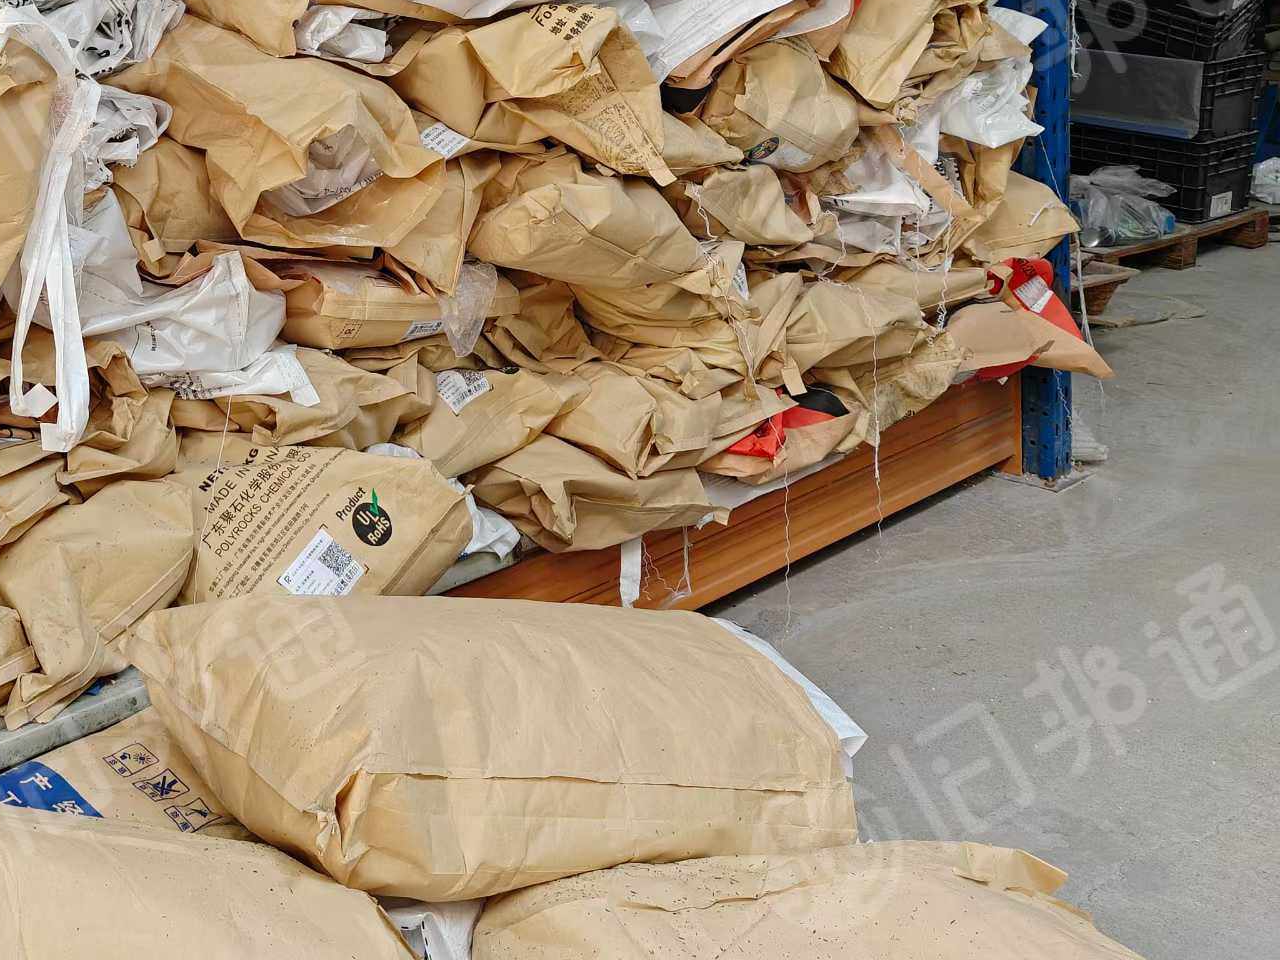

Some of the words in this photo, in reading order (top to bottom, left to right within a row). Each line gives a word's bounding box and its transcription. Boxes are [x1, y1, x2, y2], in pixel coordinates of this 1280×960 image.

[204, 480, 237, 514] MADE
[235, 466, 251, 479] IN
[335, 487, 367, 521] Product
[214, 503, 263, 558] POLYROCKS
[259, 463, 301, 505] CHEMICAL
[356, 511, 379, 525] UL
[367, 516, 390, 544] RoHS
